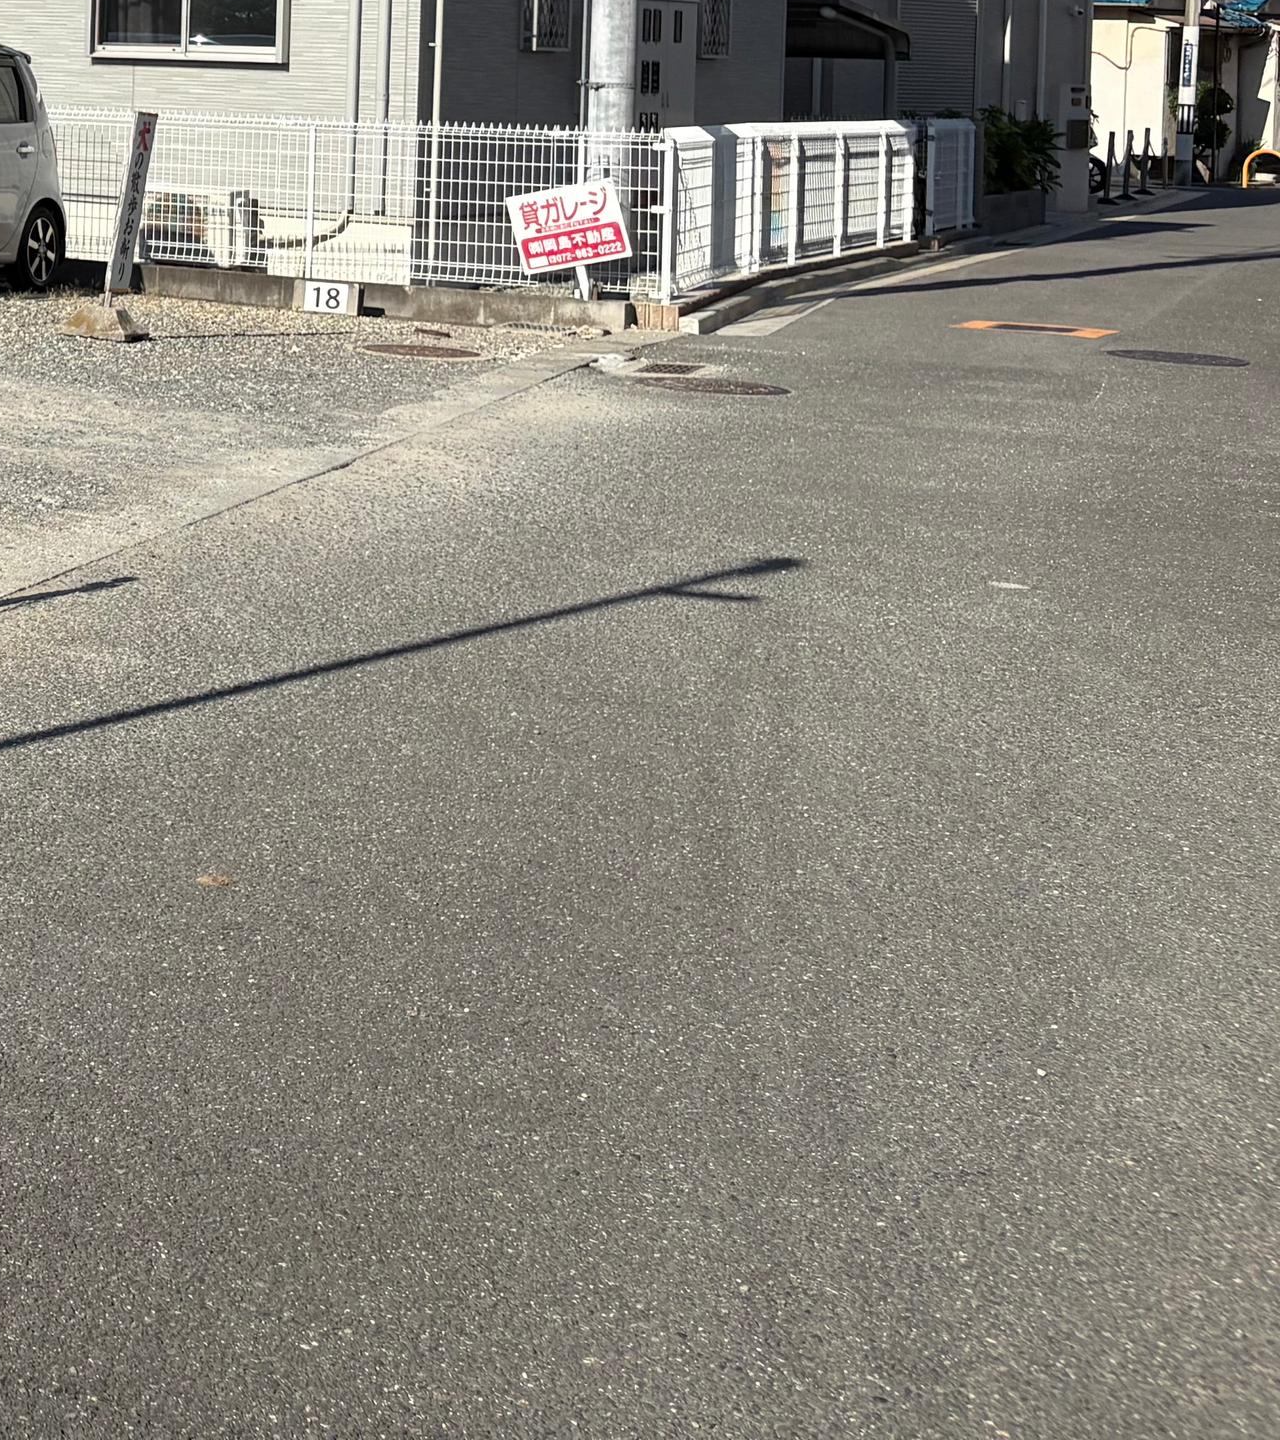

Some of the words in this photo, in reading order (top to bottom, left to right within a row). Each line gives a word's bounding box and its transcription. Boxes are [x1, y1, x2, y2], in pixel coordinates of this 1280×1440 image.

[519, 186, 607, 231] 貸ガレージ
[312, 286, 341, 310] 18
